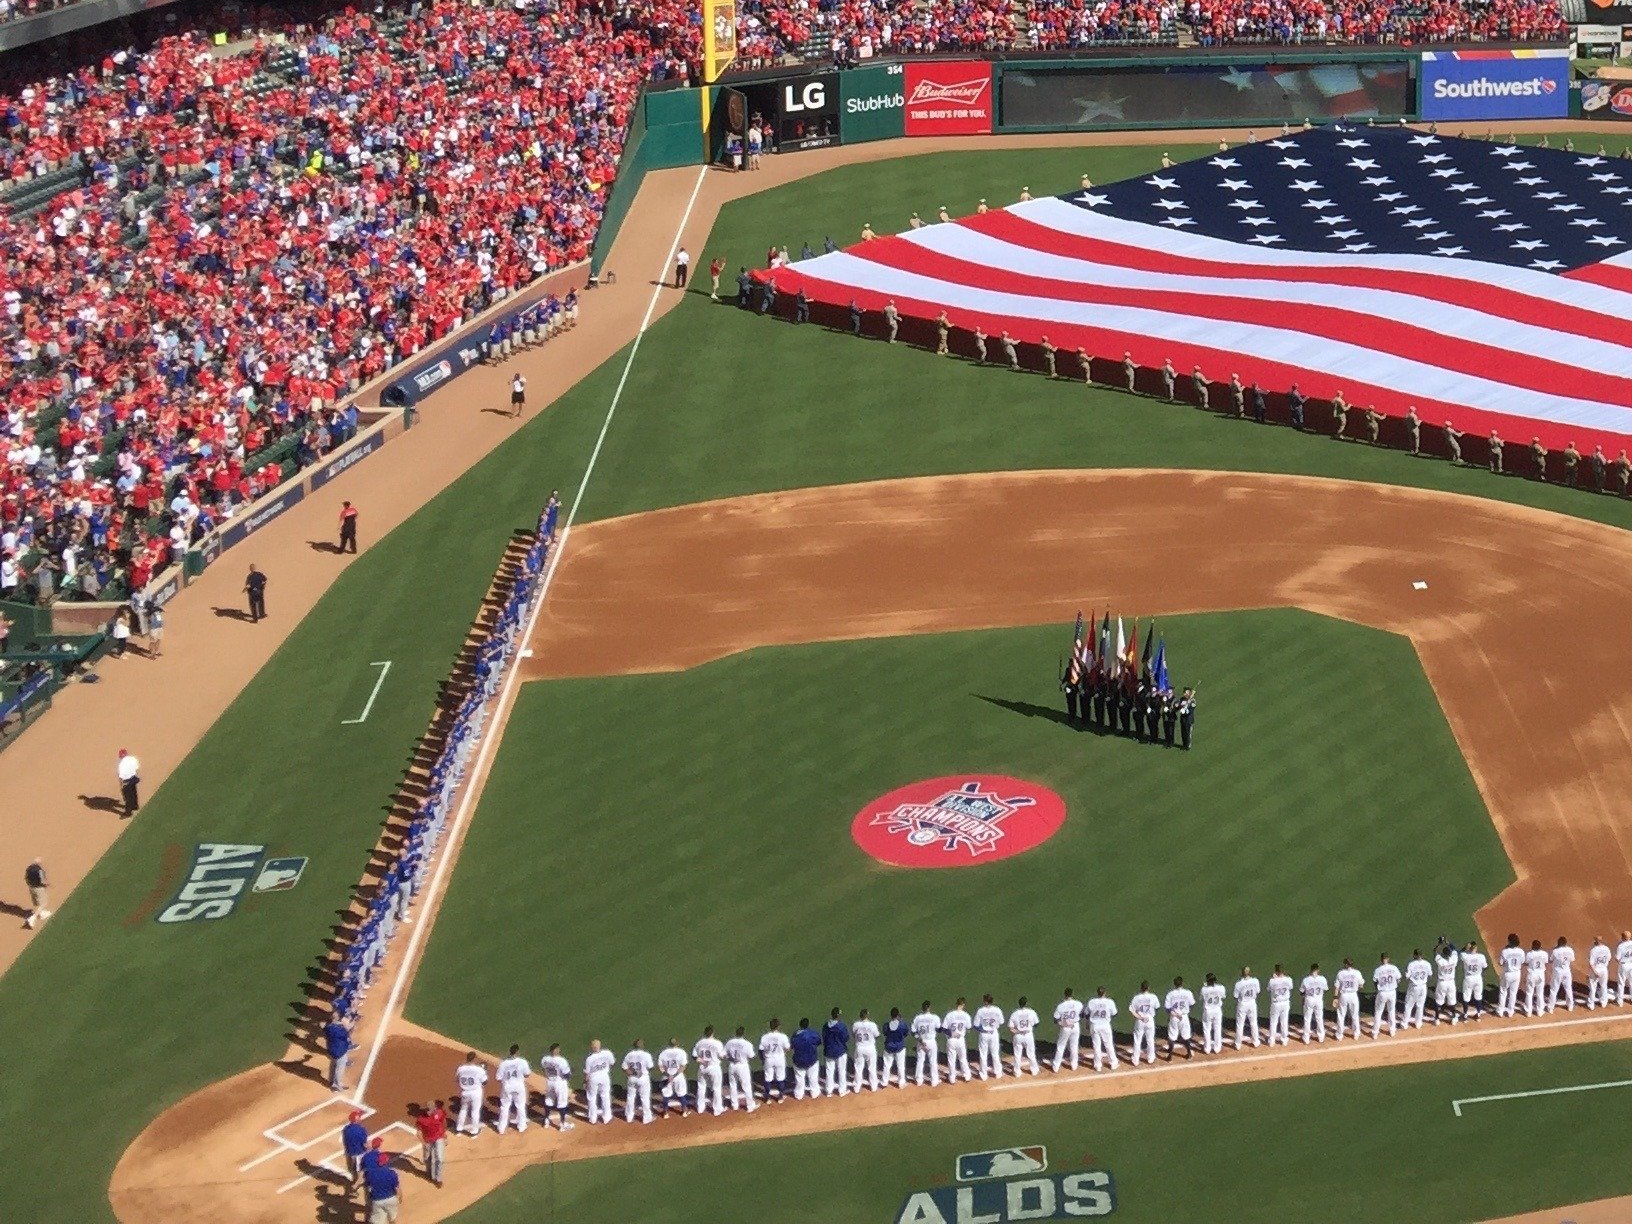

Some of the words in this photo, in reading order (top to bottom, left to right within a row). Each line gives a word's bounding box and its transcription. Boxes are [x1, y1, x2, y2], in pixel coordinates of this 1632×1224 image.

[785, 82, 825, 113] LG
[916, 82, 982, 100] Budweiser
[1433, 77, 1542, 98] Southwest
[846, 94, 905, 114] StubHub
[911, 110, 928, 120] THIS
[929, 110, 953, 119] BUD'S
[953, 109, 968, 119] FOR
[896, 806, 997, 843] CHAMPIONS
[158, 843, 265, 923] ALDS
[896, 1171, 1113, 1224] ALDS
